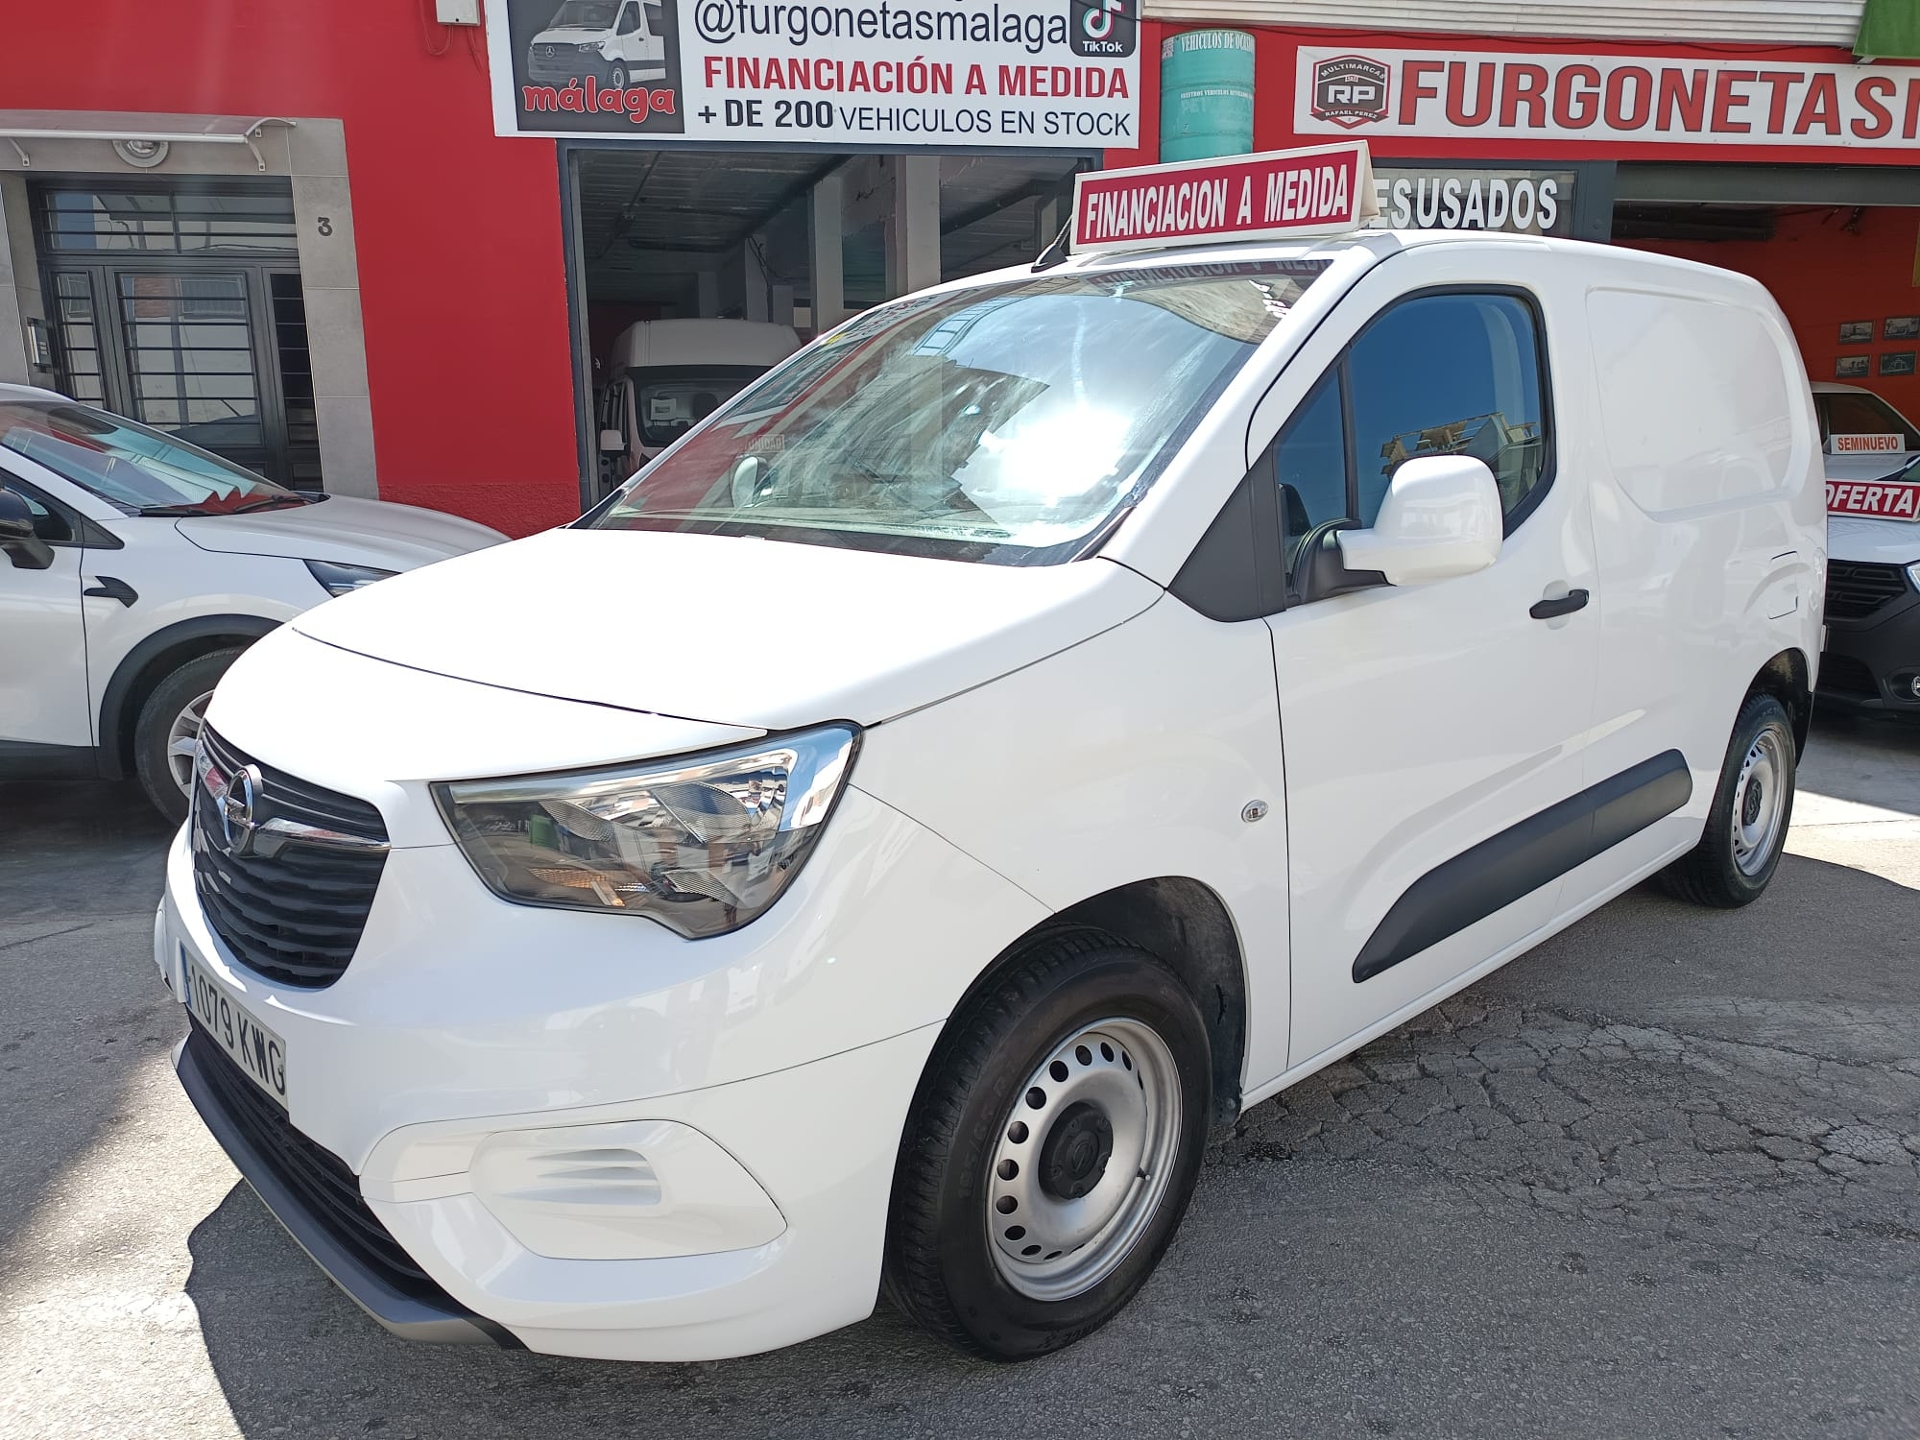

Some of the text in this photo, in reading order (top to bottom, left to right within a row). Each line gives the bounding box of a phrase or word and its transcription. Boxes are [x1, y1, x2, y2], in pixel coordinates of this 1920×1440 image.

[695, 0, 1067, 54] @furgonetasmalaga
[1083, 41, 1123, 53] TikTok
[1182, 33, 1222, 51] VEHICULOS
[1224, 33, 1233, 48] DE
[704, 55, 1129, 99] FINANCIACIÓN A MEDIDA
[1321, 63, 1385, 79] MULTIMARCAS
[522, 76, 675, 123] málaga
[1327, 85, 1376, 104] RP
[725, 100, 763, 128] DE
[774, 100, 834, 129] 200
[839, 107, 992, 134] VEHICULOS
[1001, 110, 1034, 134] EN
[1043, 111, 1131, 137] STOCK
[1085, 164, 1348, 240] FINANCIACION A MEDIDA
[317, 216, 333, 237] 3
[1837, 436, 1899, 451] SEMINUEVO
[191, 964, 286, 1096] 1079 KWG
